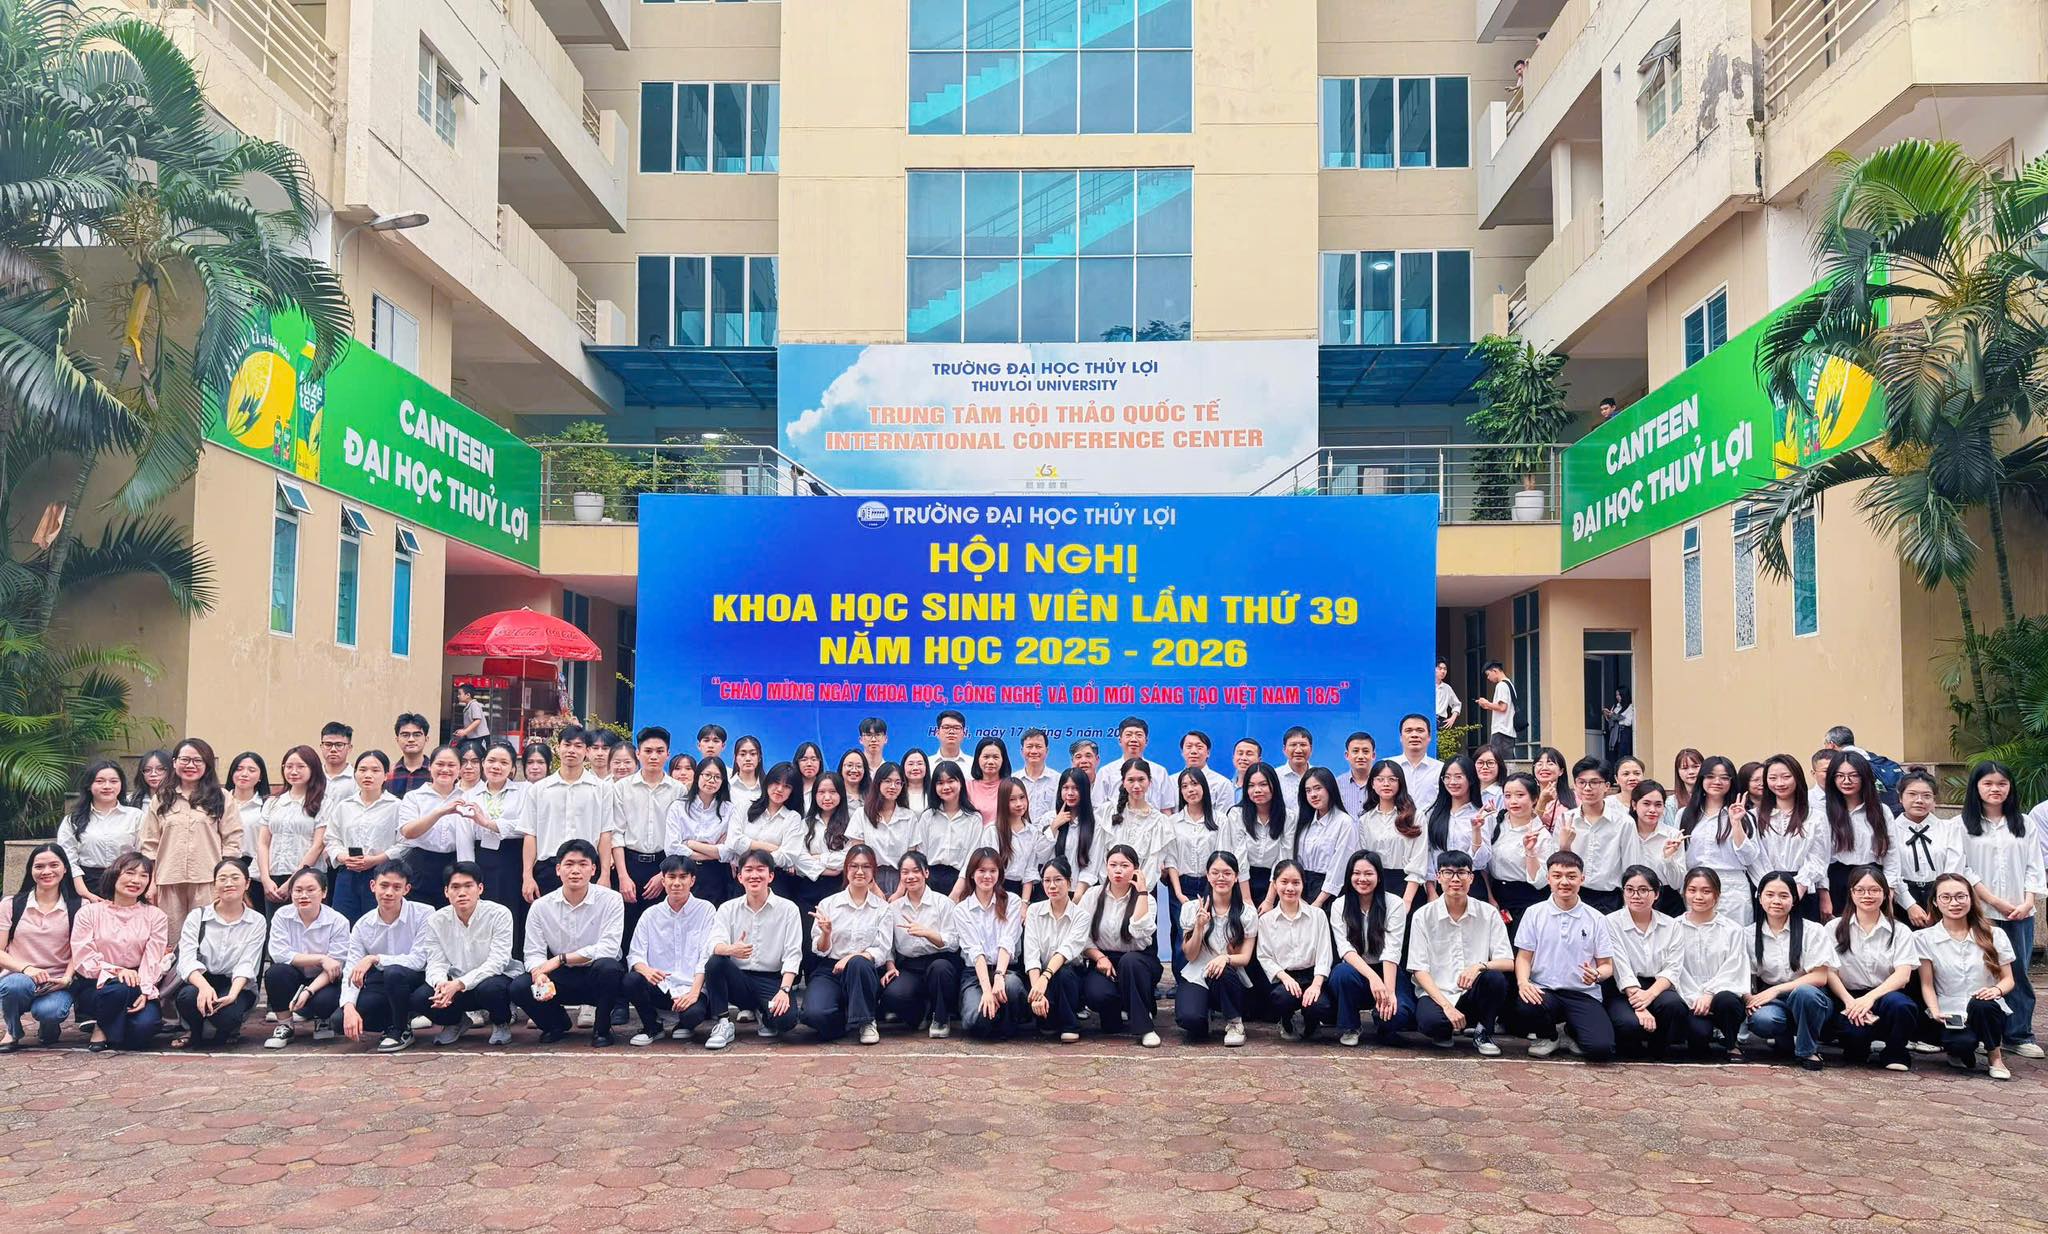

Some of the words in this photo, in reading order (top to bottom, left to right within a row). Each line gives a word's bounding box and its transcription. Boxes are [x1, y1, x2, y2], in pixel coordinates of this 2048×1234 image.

[932, 359, 1001, 376] TRƯỜNG
[1006, 362, 1036, 378] ĐẠI
[1041, 362, 1080, 378] HỌC
[1084, 357, 1127, 375] THỦY
[1132, 360, 1158, 377] LỢI
[971, 379, 1032, 392] THUYLOI
[1036, 379, 1118, 392] UNIVERSITY
[868, 406, 945, 424] TRUNG
[952, 403, 1001, 424] TÂM
[1009, 402, 1048, 427] HỘI
[1055, 399, 1115, 424] THẢO
[1123, 398, 1186, 425] QUỐC
[1192, 398, 1221, 422] TẾ
[399, 399, 495, 478] CANTEEN
[825, 431, 1006, 450] INTERNATIONAL
[1013, 431, 1165, 449] CONFERENCE
[1172, 429, 1264, 448] CENTER
[1605, 393, 1698, 476] CANTEEN
[343, 426, 390, 485] ĐẠI
[395, 451, 442, 504] HỌC
[501, 504, 529, 544] LỢI
[1572, 500, 1601, 543] ĐẠI
[1604, 479, 1644, 528] HỌC
[1711, 420, 1753, 478] LỢI
[893, 501, 980, 525] TRƯỜNG
[985, 506, 1022, 528] ĐẠI
[1029, 507, 1077, 530] HỌC
[1084, 502, 1136, 525] THỦY
[1143, 506, 1176, 531] LỢI
[930, 534, 1009, 582] HỘI
[1025, 543, 1137, 583] NGHỊ
[712, 593, 818, 622] KHOA
[831, 592, 908, 627] HỌC
[921, 592, 1016, 622] SINH
[1028, 588, 1118, 622] VIÊN
[1132, 585, 1208, 623] LẦN
[1221, 590, 1301, 624] THỨ
[1309, 597, 1359, 625] 39
[819, 630, 910, 665] NĂM
[924, 636, 1003, 671] HỌC
[1015, 636, 1111, 666] 2025
[1151, 638, 1248, 667] 2026
[766, 678, 815, 702] MỪNG
[818, 679, 862, 703] NGÀY
[865, 684, 908, 703] KHOA
[912, 684, 949, 708] HỌC,
[953, 682, 997, 704] CÔNG
[1001, 682, 1043, 708] NGHỆ
[1047, 682, 1068, 705] VÀ
[1072, 680, 1099, 705] ĐỔI
[1104, 682, 1136, 705] MỚI
[1139, 682, 1185, 705] SÁNG
[1188, 685, 1219, 710] TẠO
[1223, 682, 1258, 710] VIỆT
[1261, 685, 1301, 706] NAM
[975, 726, 1006, 738] ngày
[1010, 727, 1023, 737] 17
[1065, 727, 1073, 737] 5
[1076, 727, 1104, 738] năm
